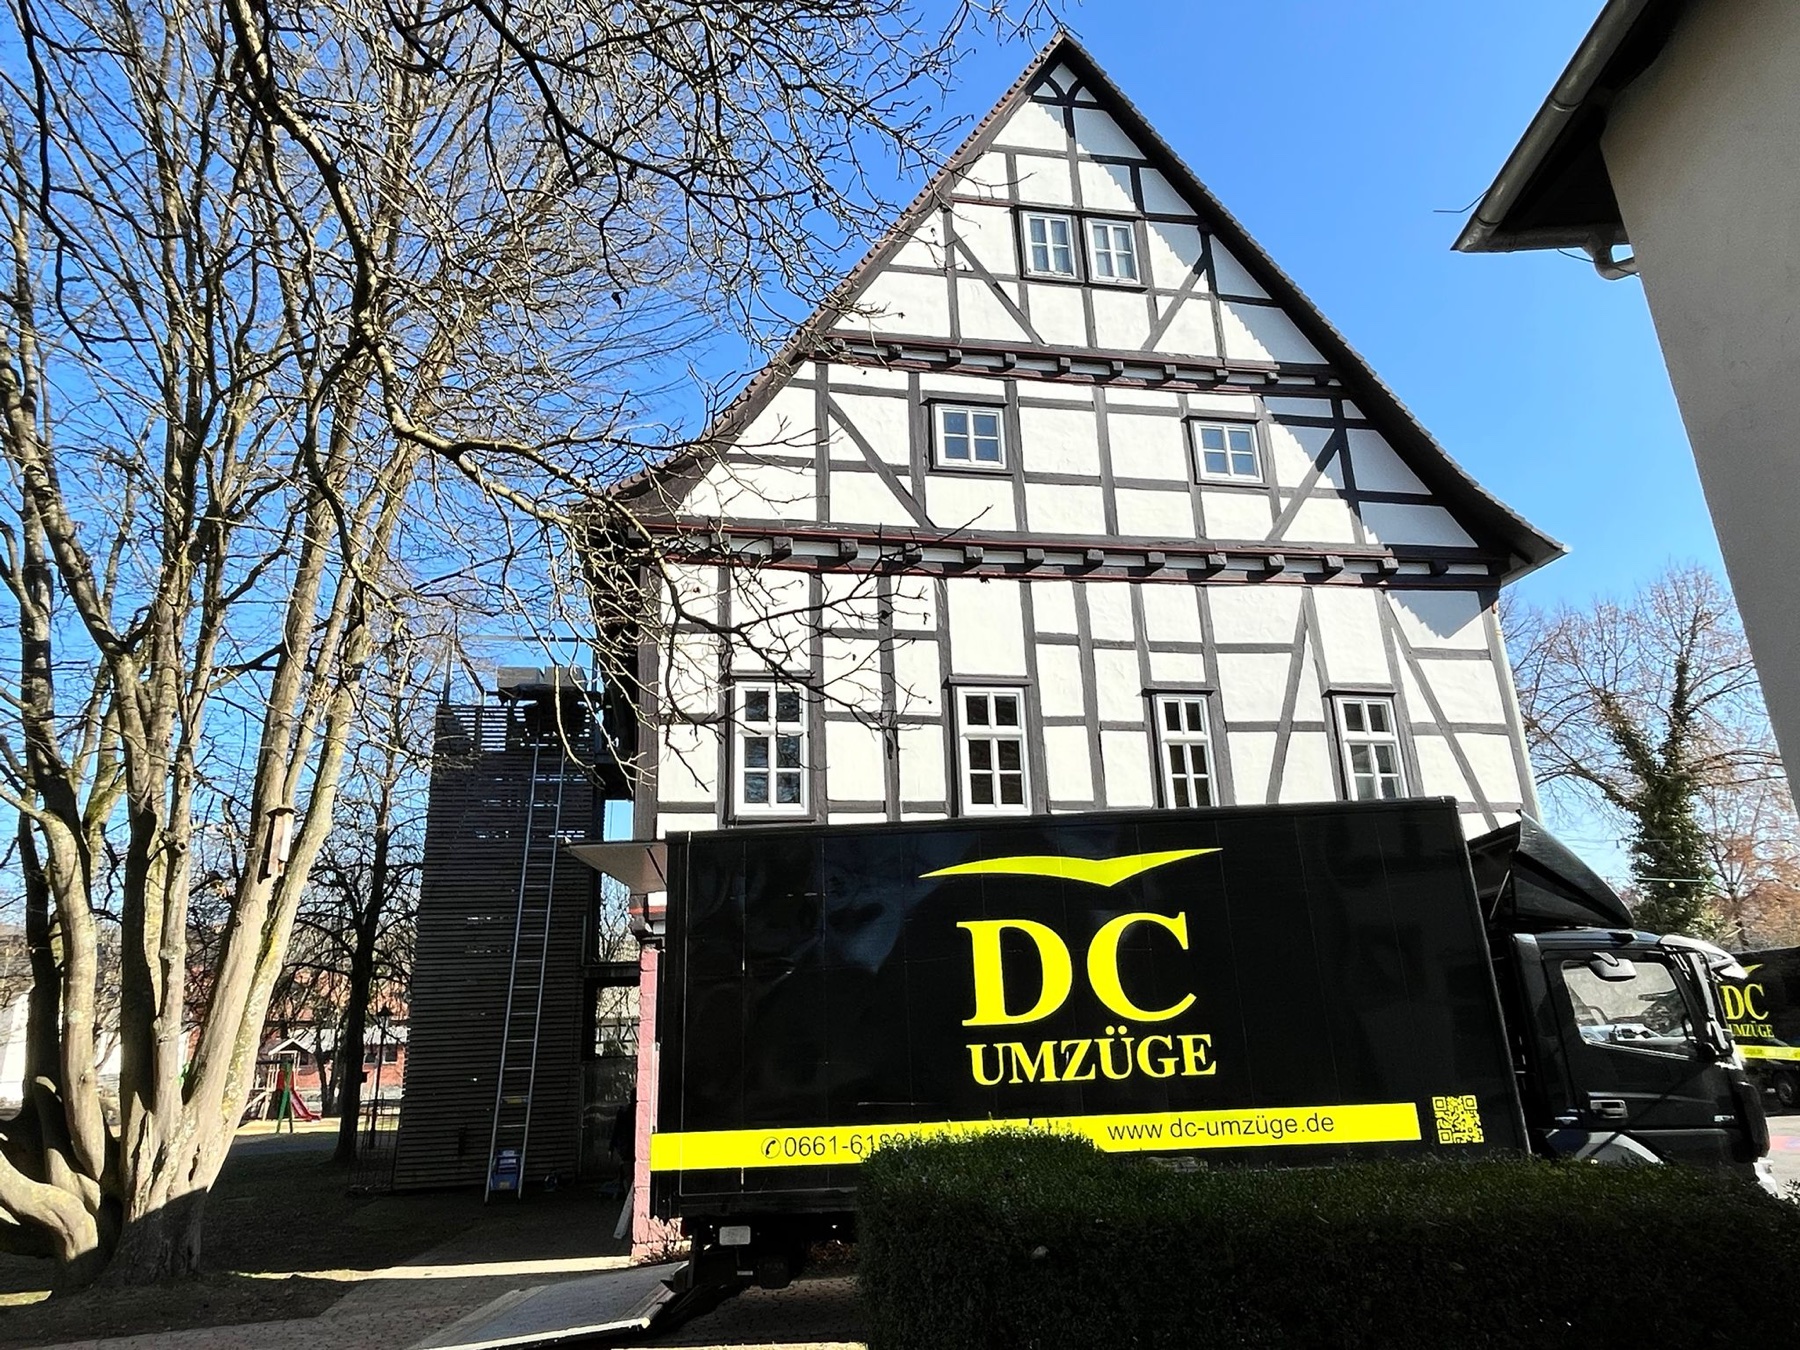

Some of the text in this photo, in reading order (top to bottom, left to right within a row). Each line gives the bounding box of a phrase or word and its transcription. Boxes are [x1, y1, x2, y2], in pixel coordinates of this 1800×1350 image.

[956, 912, 1197, 1026] DC
[1720, 983, 1769, 1020] DC
[966, 1025, 1217, 1085] UMZÜGE
